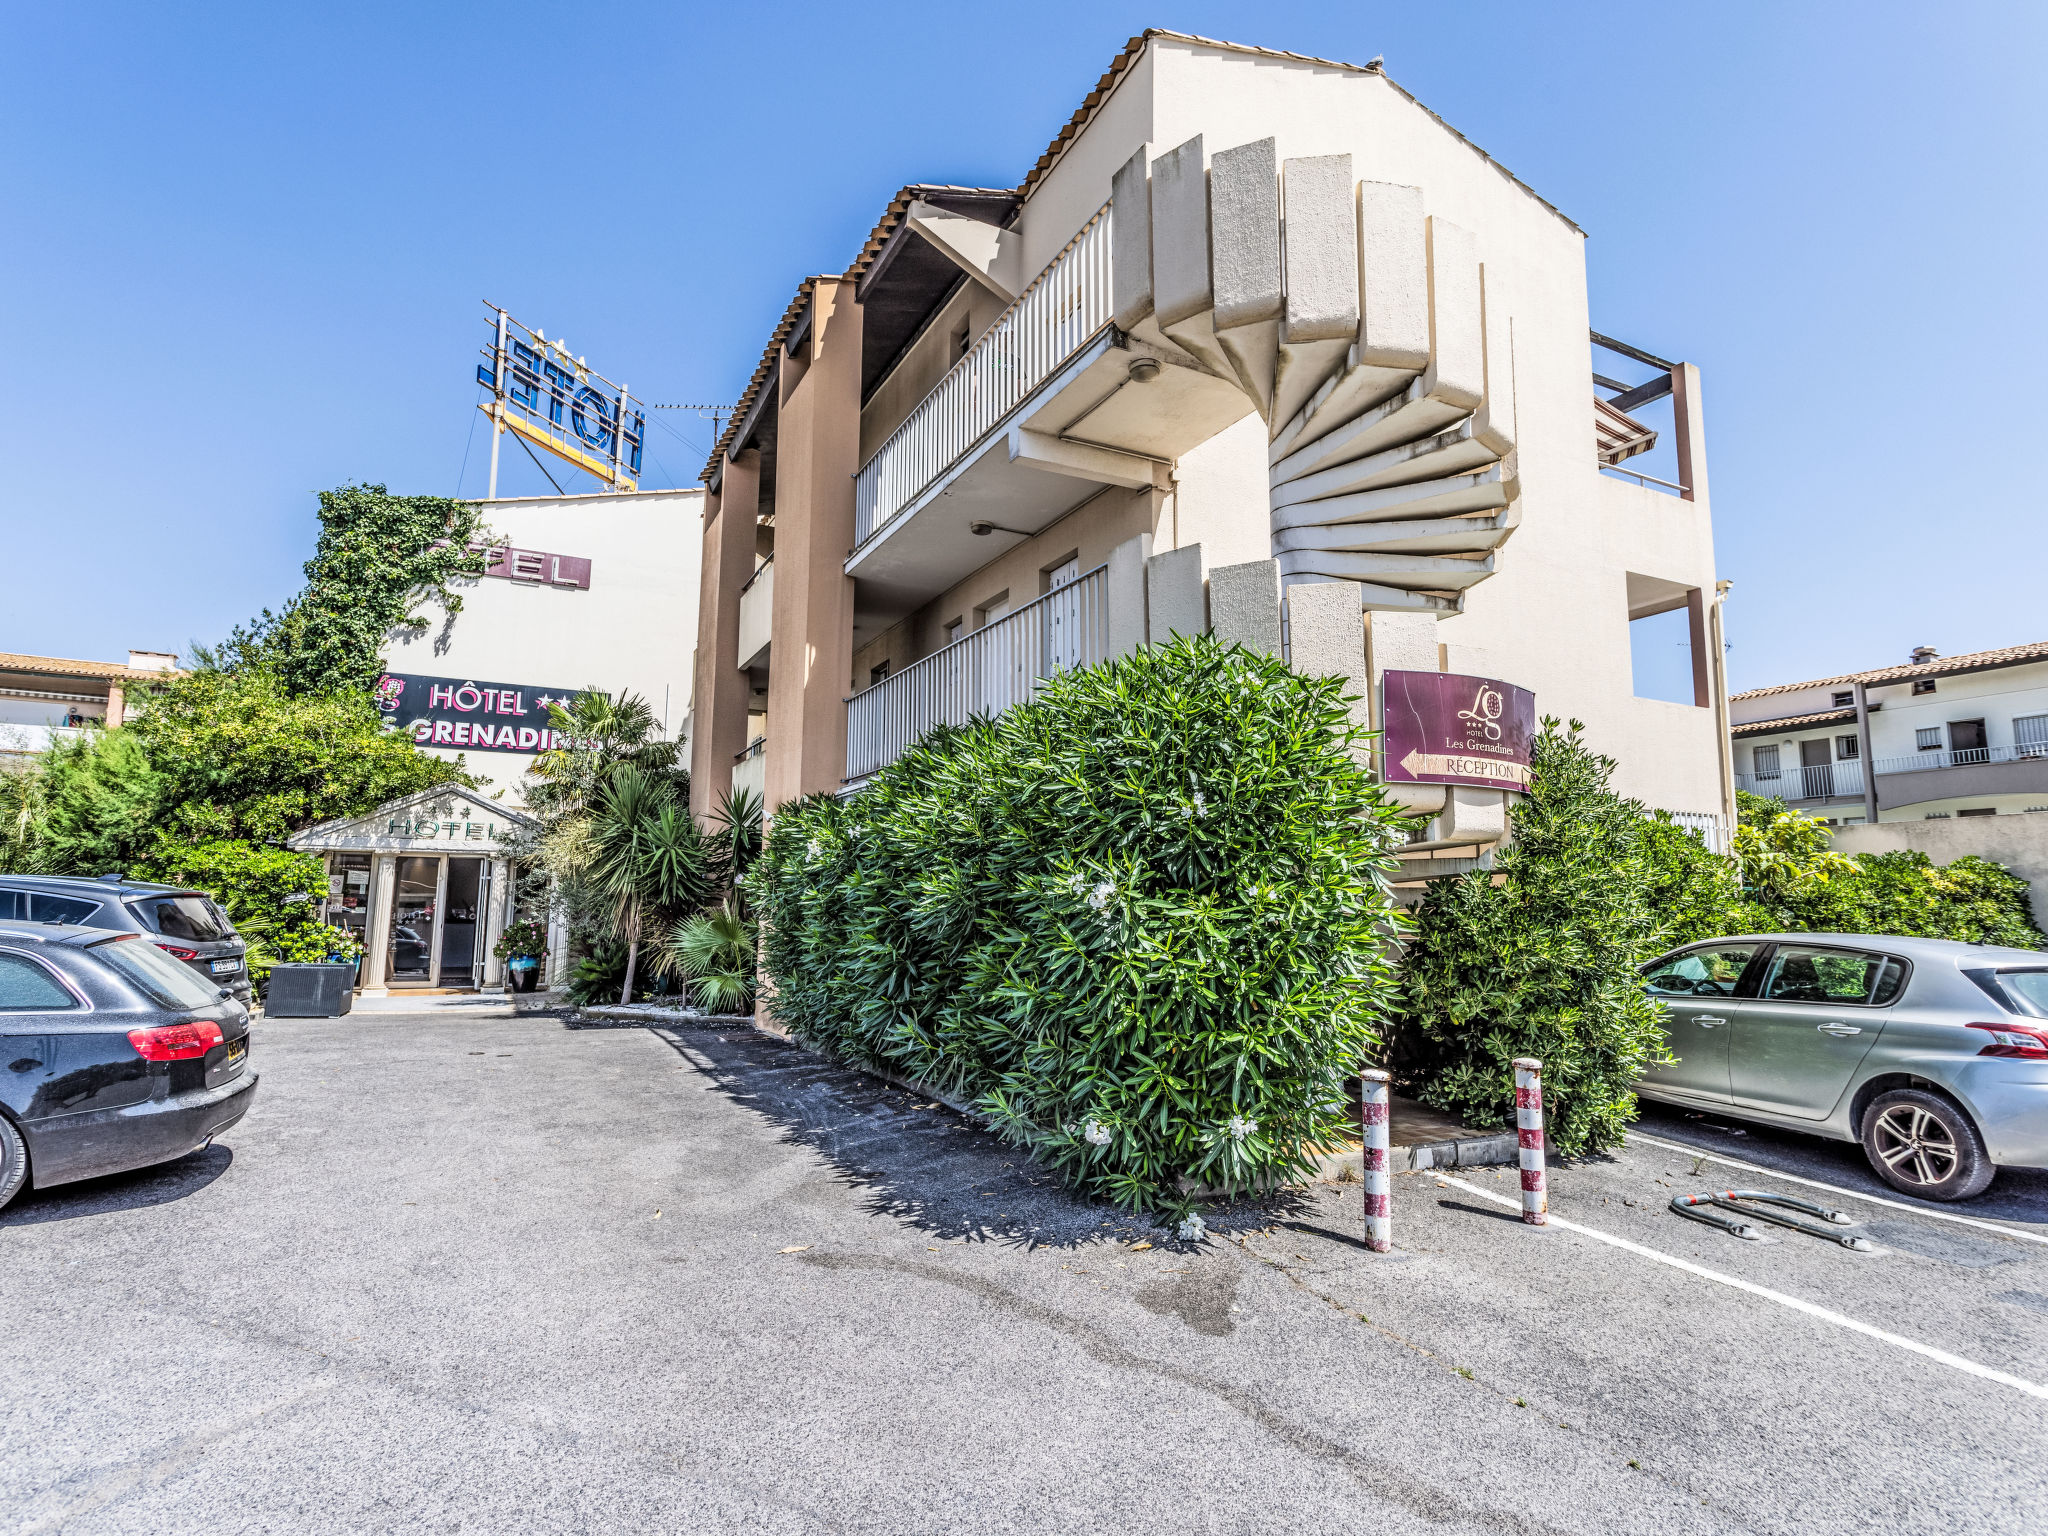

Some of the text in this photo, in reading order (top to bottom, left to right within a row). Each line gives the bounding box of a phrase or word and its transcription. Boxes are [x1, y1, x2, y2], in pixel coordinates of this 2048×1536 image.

[430, 538, 580, 584] TEL
[429, 680, 528, 716] HÔTEL
[409, 718, 604, 751] GRENADIN
[1446, 737, 1514, 756] Les Grenadines
[1466, 730, 1484, 738] HOTEL
[1446, 757, 1514, 778] RÉCEPTION
